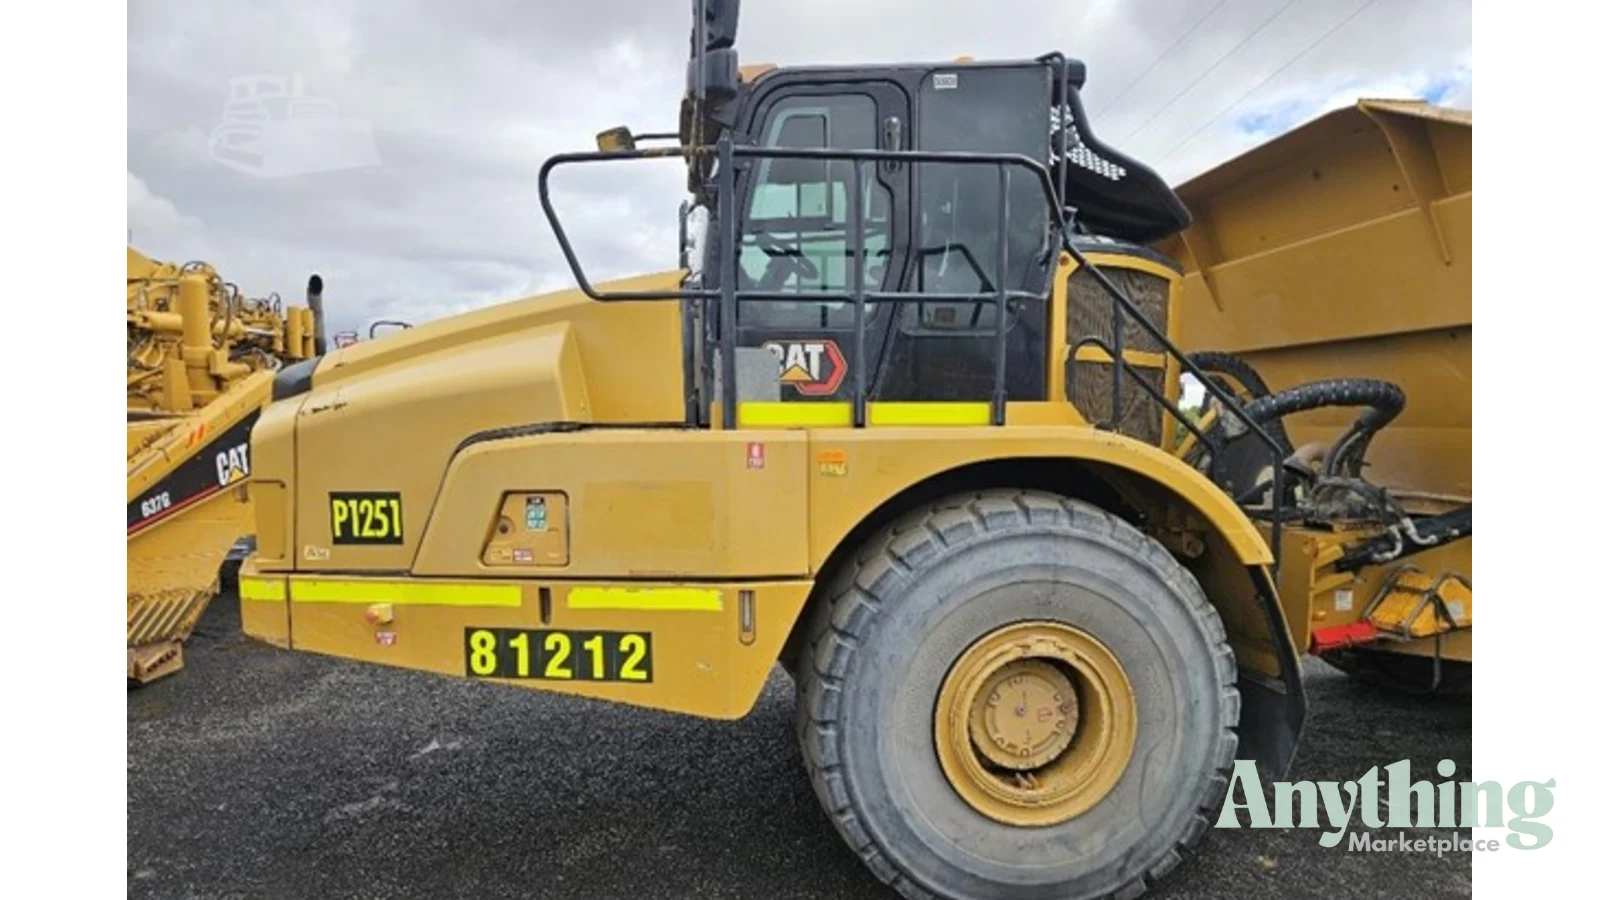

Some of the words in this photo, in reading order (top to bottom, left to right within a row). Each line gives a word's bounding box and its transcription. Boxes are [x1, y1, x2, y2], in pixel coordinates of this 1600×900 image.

[216, 442, 249, 486] CAT
[332, 499, 401, 538] P1251
[469, 630, 648, 680] 81212
